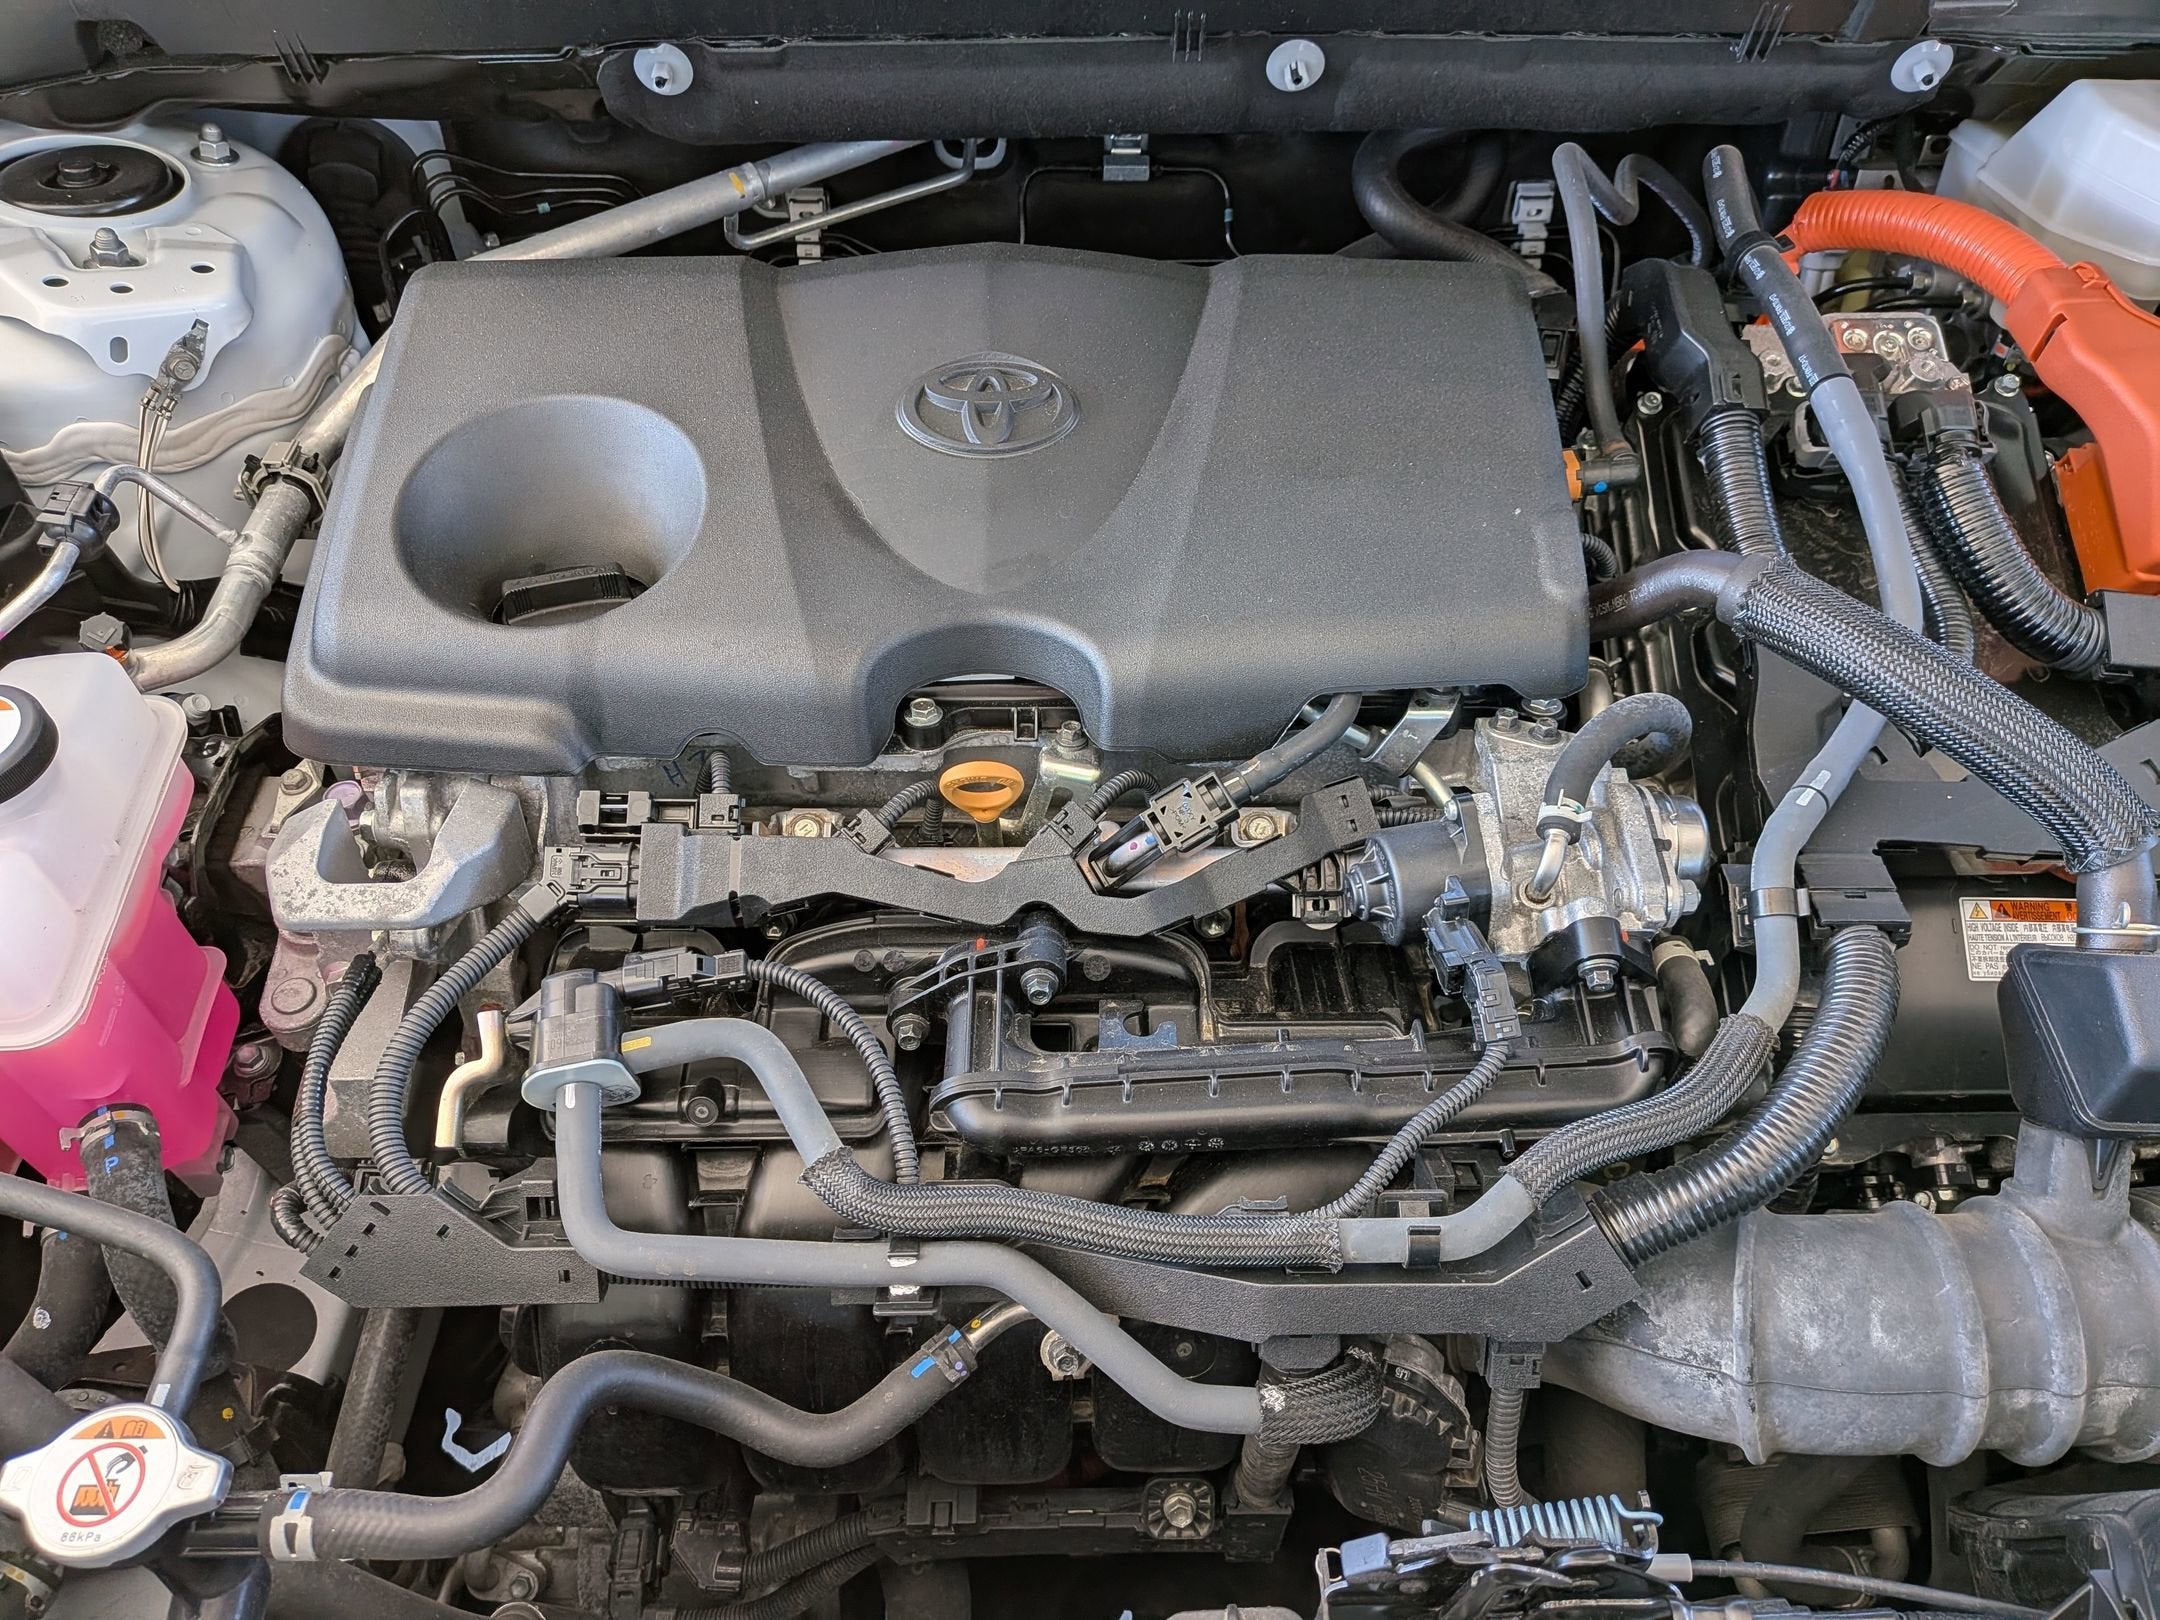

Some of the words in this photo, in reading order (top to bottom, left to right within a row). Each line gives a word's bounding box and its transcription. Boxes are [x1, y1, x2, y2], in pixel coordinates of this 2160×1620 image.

[2010, 901, 2050, 912] WARNING
[2012, 911, 2061, 920] AVERTISSEMENT
[1980, 923, 2002, 932] VOLTAGE
[2003, 923, 2019, 932] INSIDE
[1968, 934, 1984, 942] HAUTE
[1985, 934, 2004, 942] TENSION
